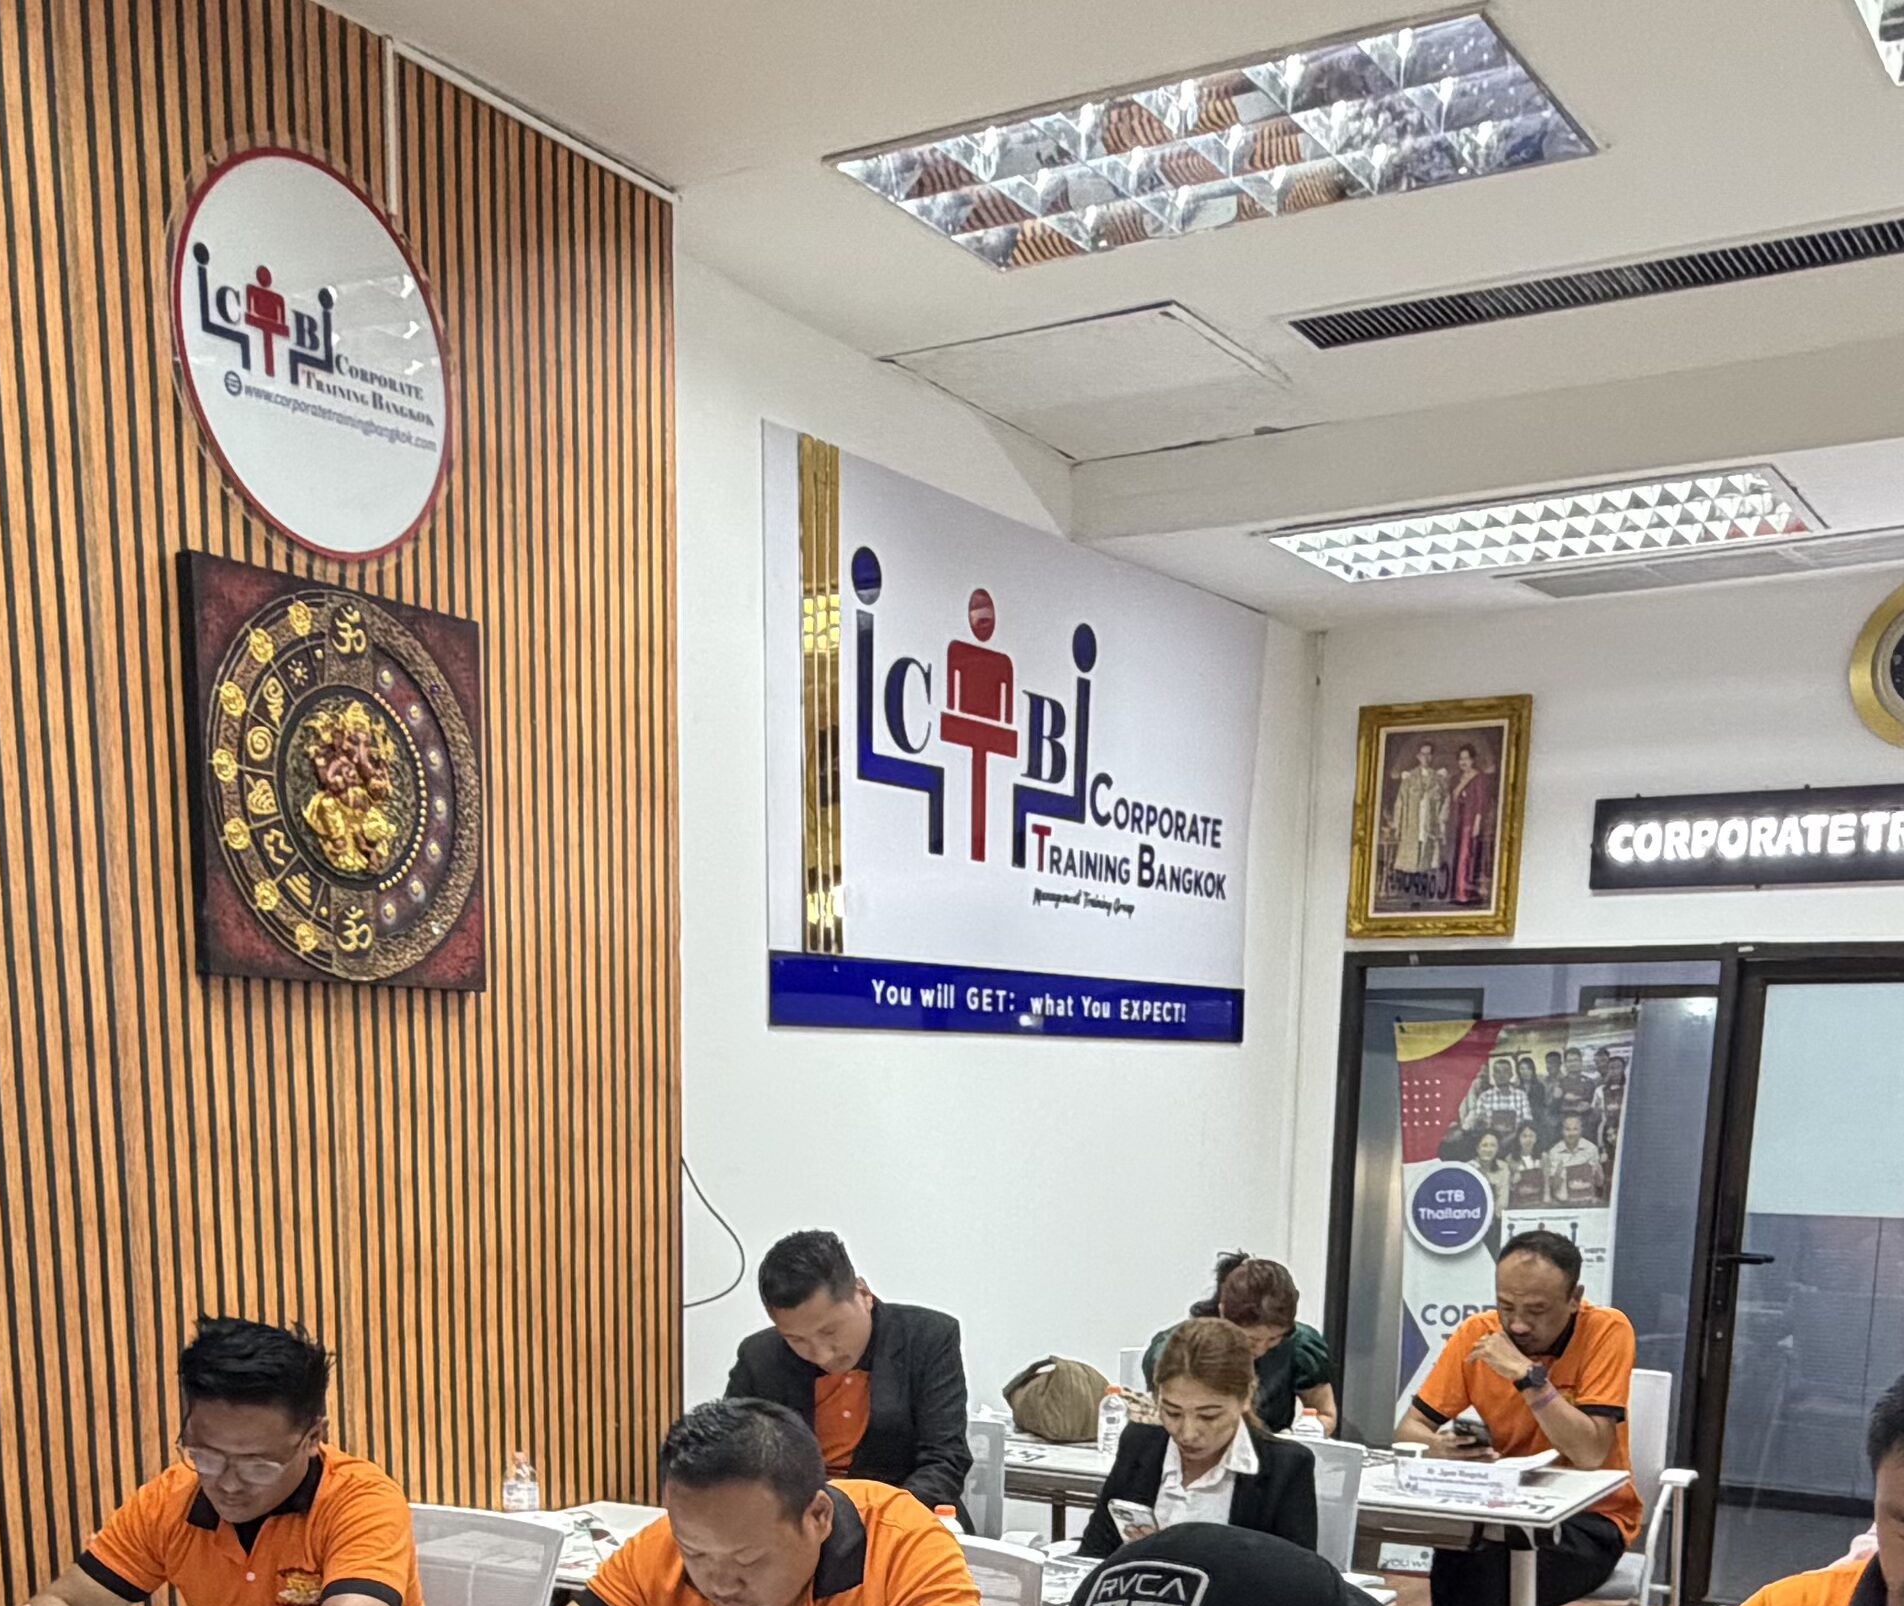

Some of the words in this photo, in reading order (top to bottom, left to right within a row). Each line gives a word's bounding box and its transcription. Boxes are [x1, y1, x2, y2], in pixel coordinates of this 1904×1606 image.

[335, 354, 424, 400] CORPORATE
[1090, 772, 1223, 848] CORPORATE
[1606, 813, 1856, 865] CORPORATE
[1032, 823, 1131, 885] TRAINING
[1137, 843, 1226, 901] BANGKOK
[871, 978, 912, 1005] You
[920, 983, 955, 1009] will
[1030, 993, 1074, 1017] what
[1081, 996, 1111, 1018] You
[1120, 999, 1187, 1023] EXPECT!
[1418, 1206, 1481, 1221] Thailand
[1434, 1189, 1466, 1203] CTB
[1098, 1573, 1187, 1601] RVCA
